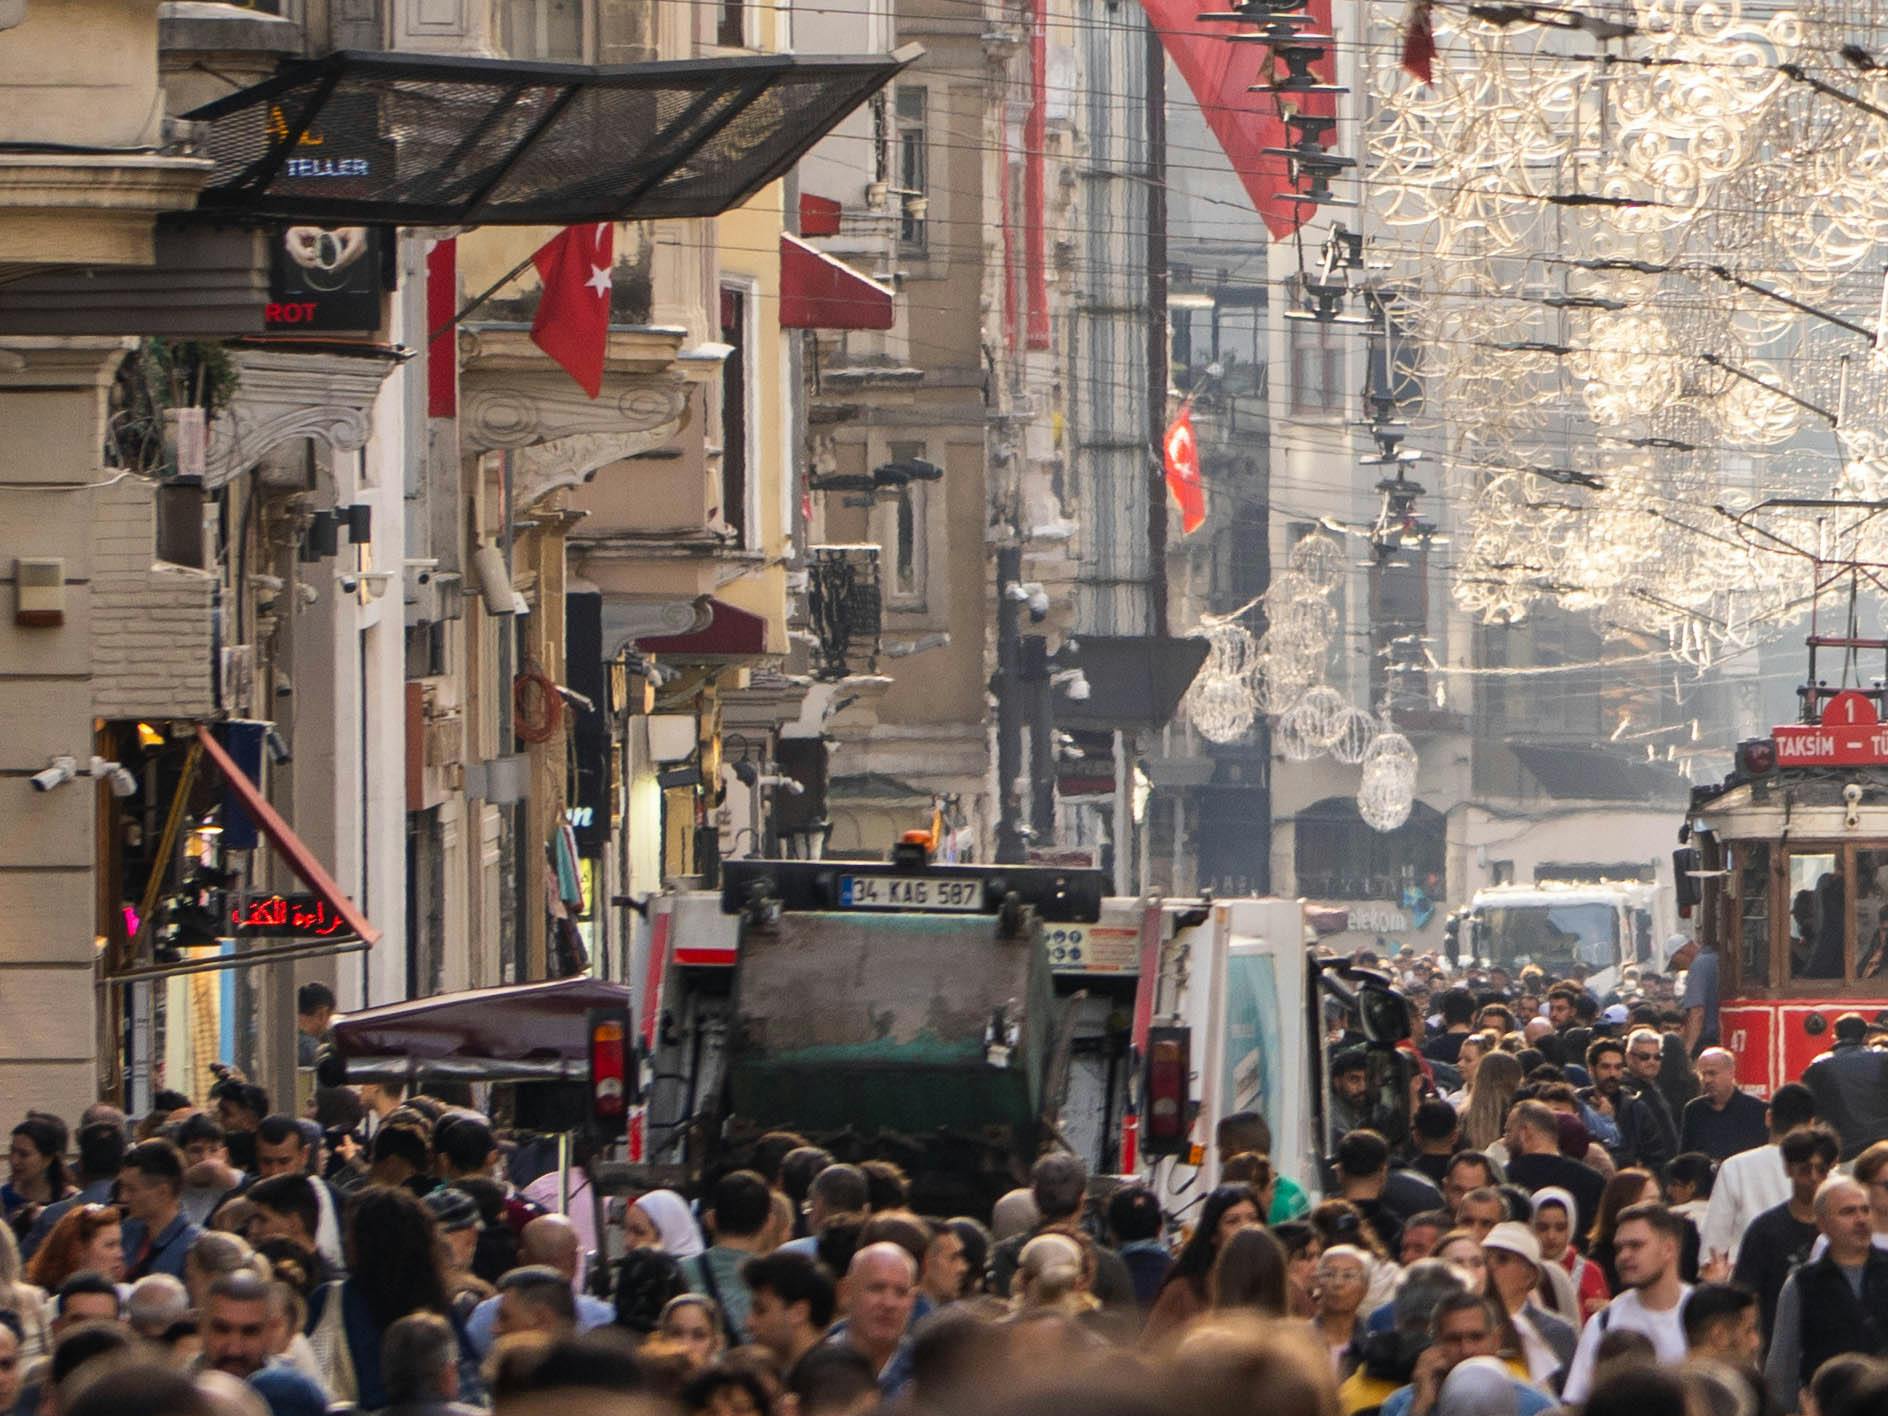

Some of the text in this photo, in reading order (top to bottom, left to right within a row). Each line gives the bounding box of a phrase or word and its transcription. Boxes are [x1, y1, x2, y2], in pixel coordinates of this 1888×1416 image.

[287, 158, 369, 177] TELLER
[265, 302, 318, 321] ROT
[1844, 698, 1854, 723] 1
[1776, 731, 1834, 757] TAKSİM
[853, 879, 878, 903] 34
[1348, 906, 1408, 932] elekom
